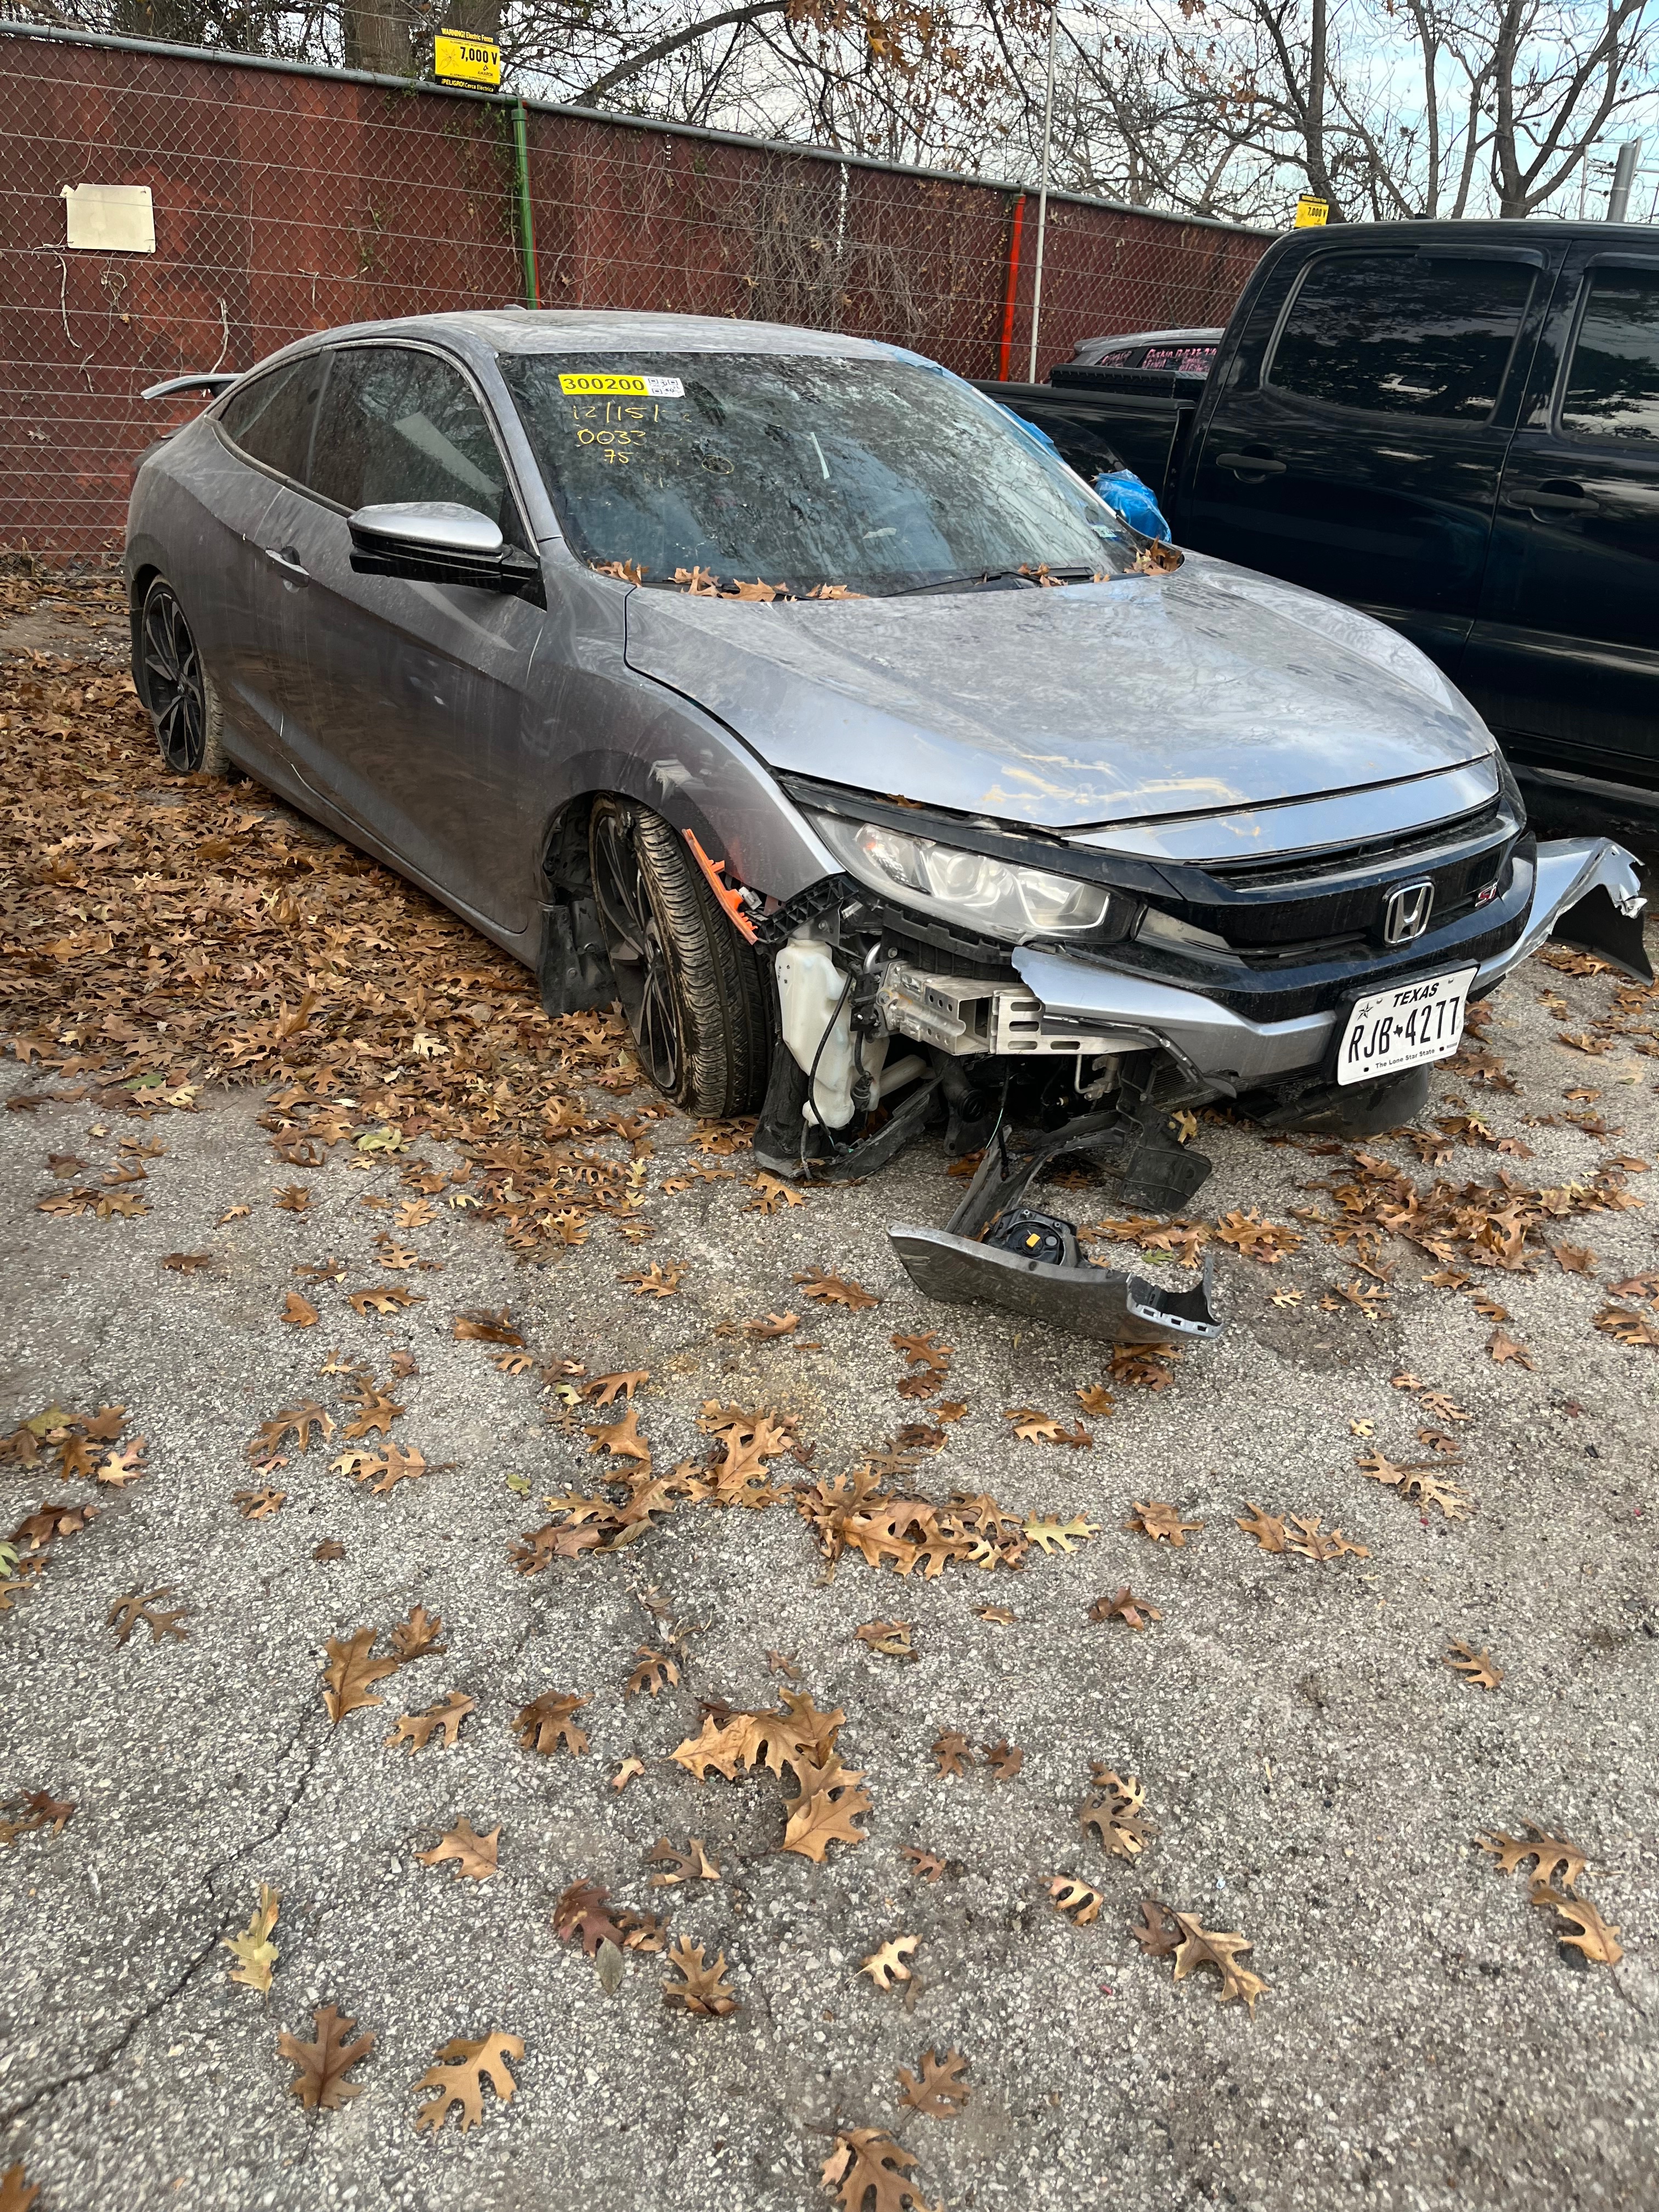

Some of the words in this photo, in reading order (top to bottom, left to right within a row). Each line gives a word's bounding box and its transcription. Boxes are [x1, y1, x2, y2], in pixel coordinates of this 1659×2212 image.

[441, 27, 465, 38] WARNING!
[466, 32, 481, 41] Electric
[460, 46, 489, 63] 7,000
[491, 52, 498, 65] V
[563, 378, 645, 391] 300200
[1392, 982, 1440, 1008] TEXAS
[1389, 1057, 1404, 1065] Lone
[1406, 1053, 1418, 1061] Star
[1419, 1048, 1435, 1057] State
